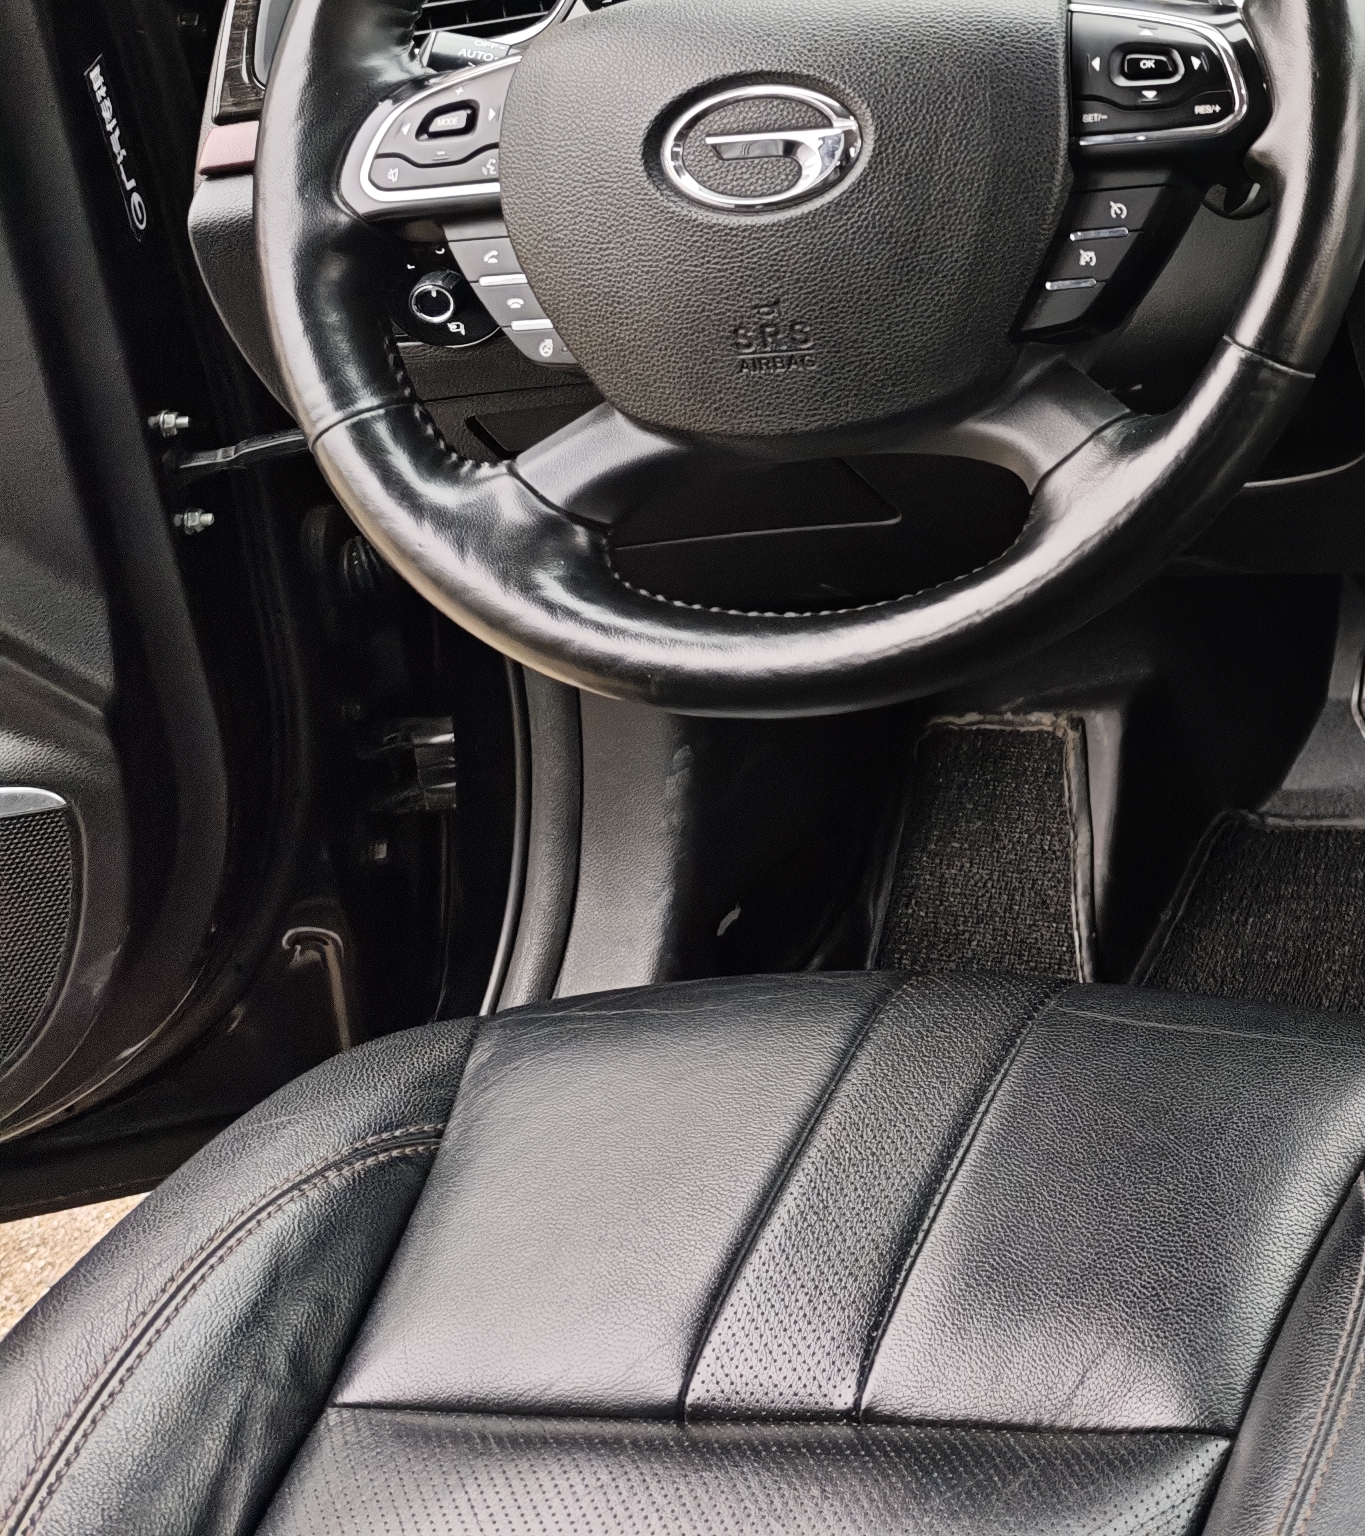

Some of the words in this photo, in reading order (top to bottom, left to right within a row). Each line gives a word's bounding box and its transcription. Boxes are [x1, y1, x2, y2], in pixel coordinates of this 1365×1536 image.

[457, 48, 494, 61] AUTO
[1139, 59, 1155, 69] OK
[436, 116, 459, 127] MODE
